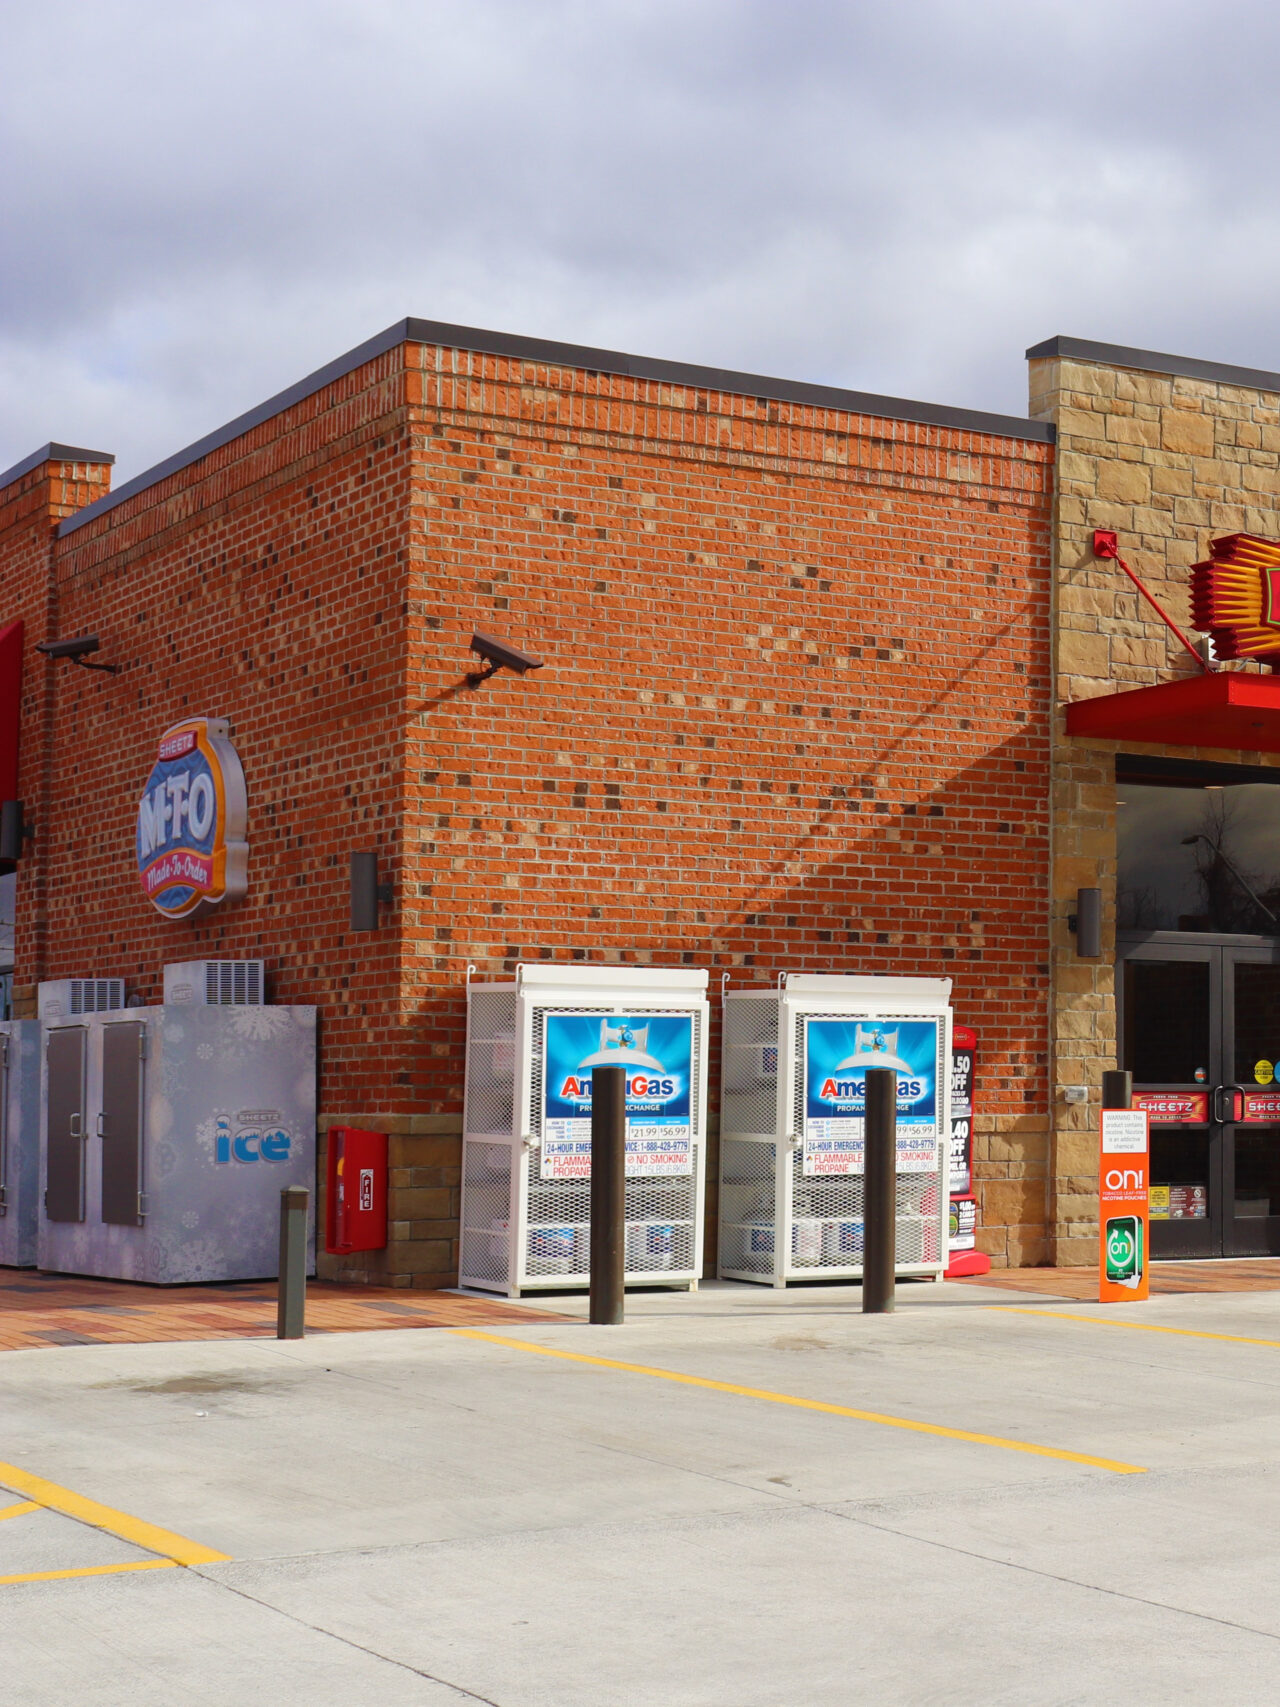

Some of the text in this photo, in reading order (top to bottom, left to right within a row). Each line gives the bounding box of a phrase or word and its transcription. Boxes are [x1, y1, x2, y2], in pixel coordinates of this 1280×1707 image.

[160, 733, 194, 757] SHEETZ
[821, 1079, 921, 1097] Ameas
[1139, 1103, 1193, 1112] SHEETZ
[238, 1113, 281, 1121] SHEETZ
[631, 1127, 657, 1138] $21.99
[660, 1127, 686, 1136] $56.99
[909, 1125, 933, 1135] $56.99
[215, 1114, 291, 1164] ice
[808, 1139, 935, 1151] 24-HOUR EMERGENC -888-428-9779
[547, 1142, 574, 1154] 24-HOUR
[553, 1153, 688, 1167] FLAMMA NO SMOKING
[814, 1153, 862, 1164] FLAMMABLE
[901, 1152, 934, 1162] SMOKING
[553, 1167, 592, 1177] PROPANE
[814, 1164, 849, 1174] PROPANE
[1105, 1170, 1143, 1190] on!
